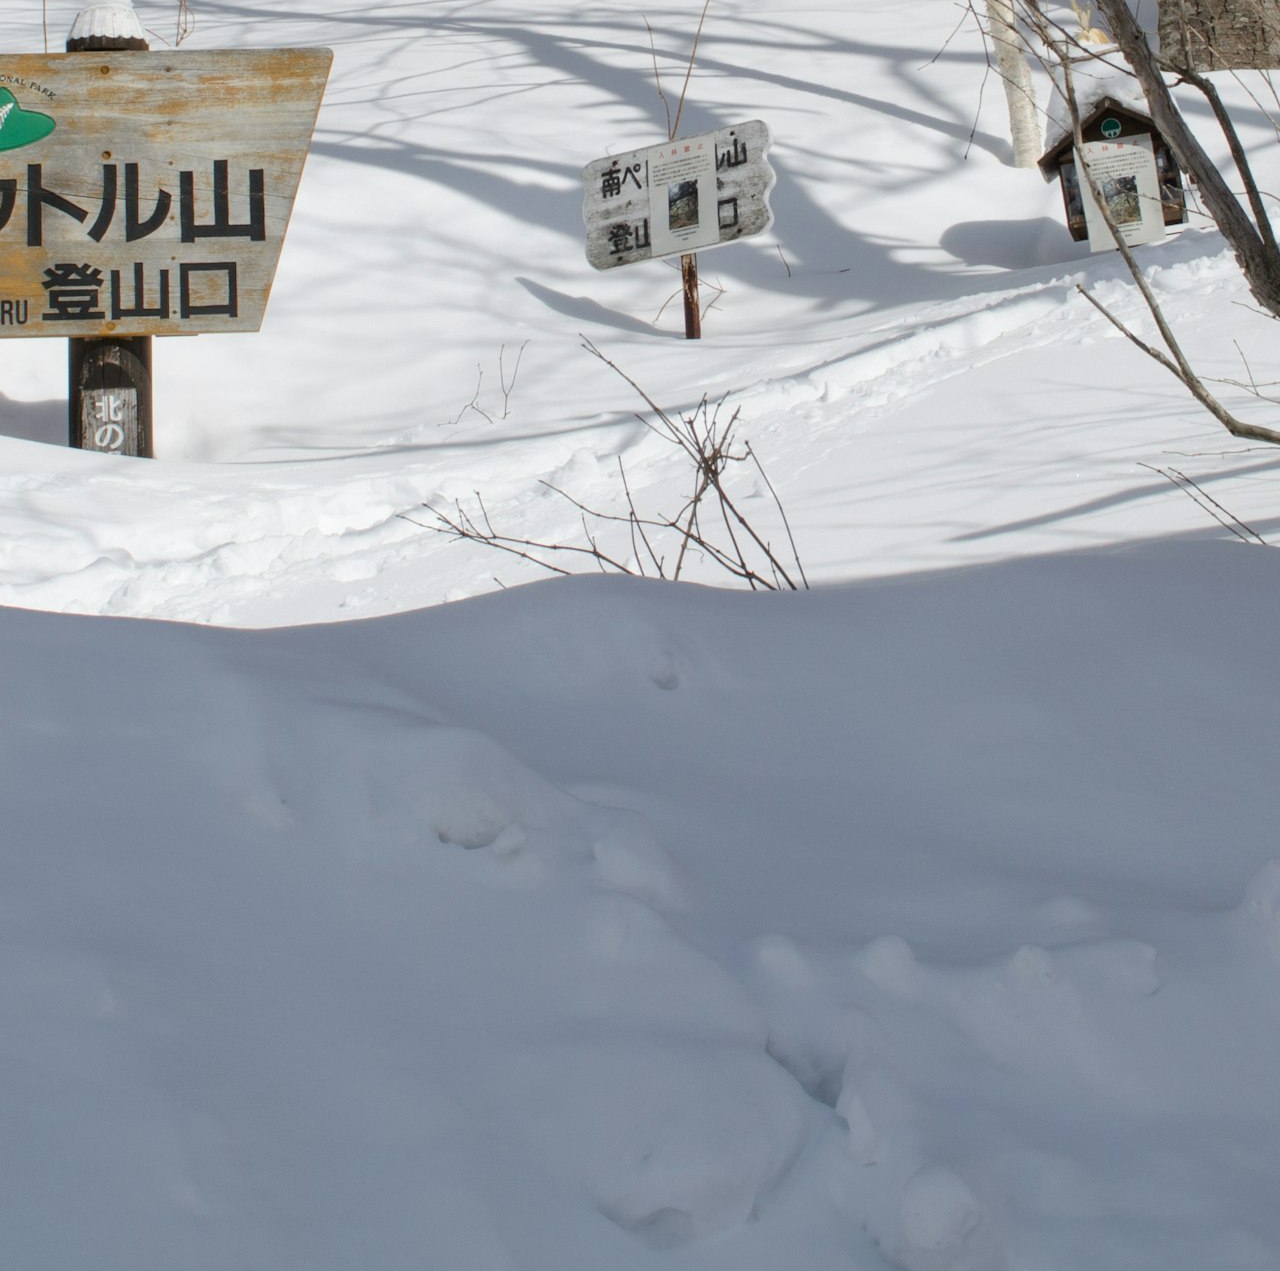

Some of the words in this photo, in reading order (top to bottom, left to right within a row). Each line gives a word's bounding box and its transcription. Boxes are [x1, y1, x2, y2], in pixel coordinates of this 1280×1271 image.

[29, 81, 58, 101] PARK
[42, 261, 239, 321] 登山口
[94, 395, 125, 455] 北の
